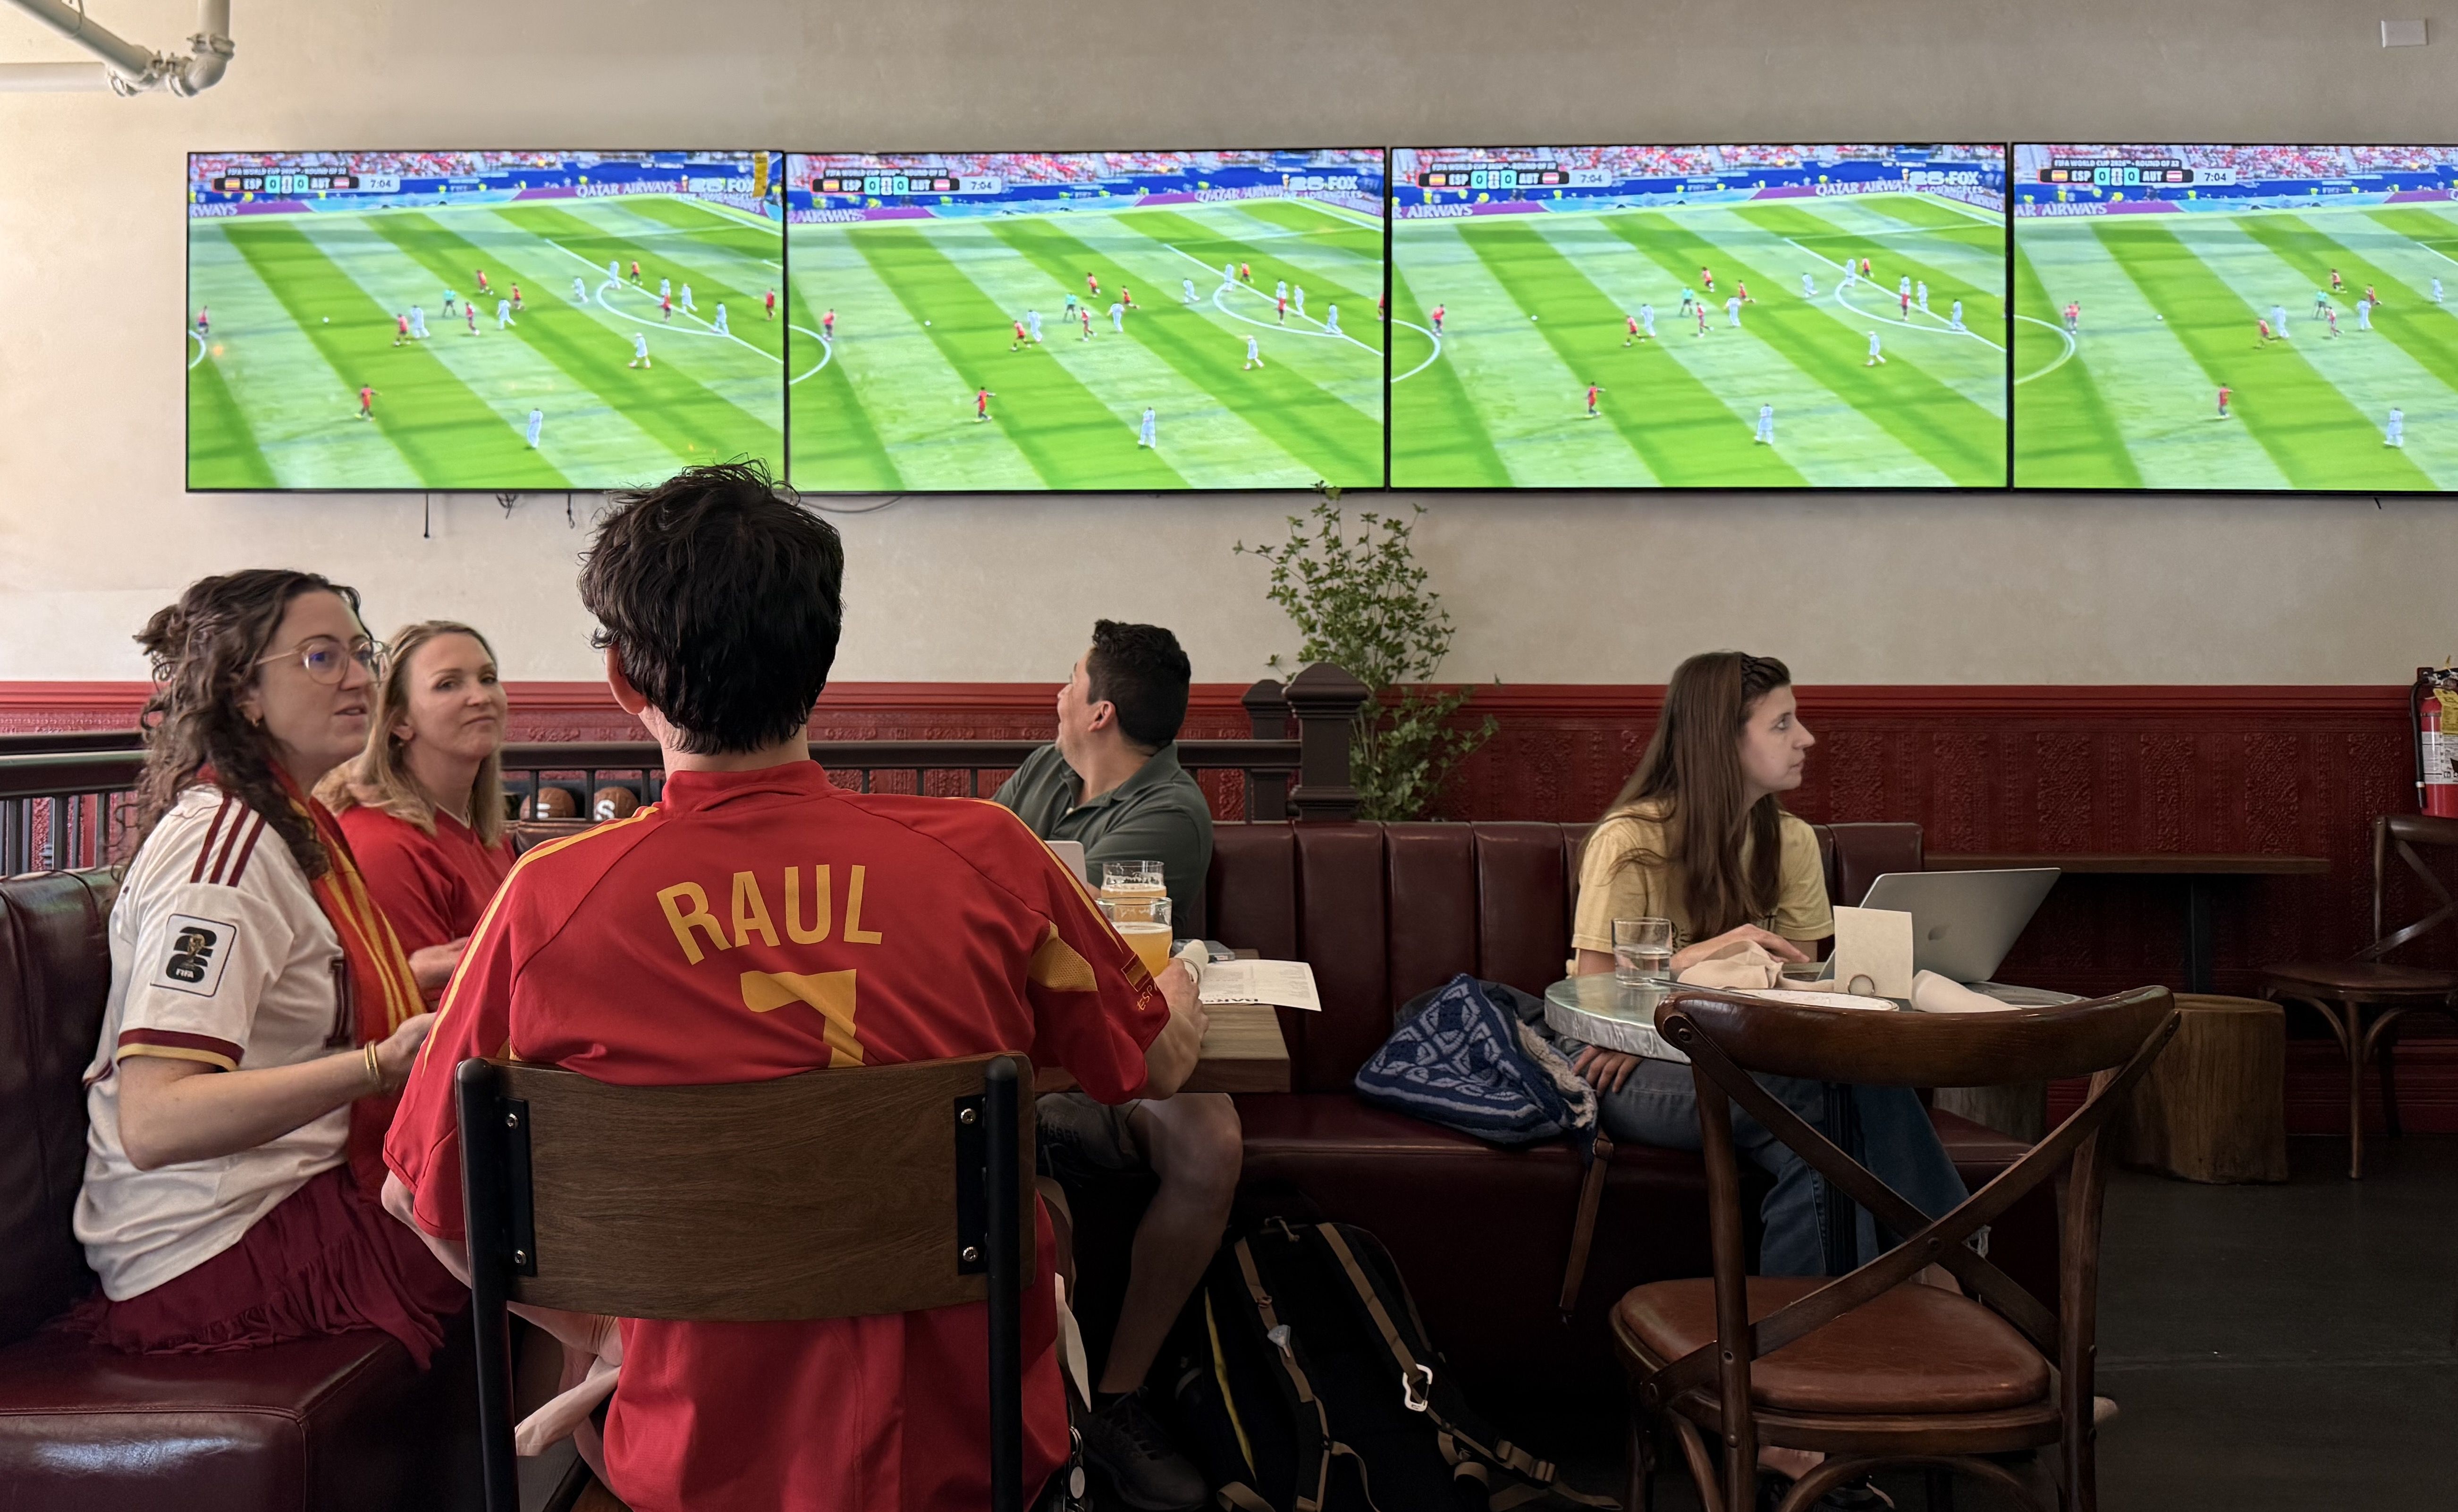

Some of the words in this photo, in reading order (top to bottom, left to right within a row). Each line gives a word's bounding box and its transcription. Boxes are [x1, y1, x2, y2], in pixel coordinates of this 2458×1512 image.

[243, 177, 262, 189] ESP
[270, 179, 276, 189] 0
[298, 179, 304, 188] 0
[371, 180, 391, 188] 7:04
[1328, 176, 1358, 190] FOX
[1476, 175, 1483, 184] 0
[1505, 175, 1512, 184] 0
[1580, 175, 1602, 183] 7:04
[1949, 171, 1979, 185] FOX
[2071, 170, 2091, 182] ESP
[2099, 171, 2106, 181] 0
[2128, 172, 2135, 181] 0
[2142, 170, 2162, 182] AUT
[2205, 173, 2226, 181] 7:04
[575, 183, 619, 197] QATAR
[623, 181, 677, 194] AIRWAYS
[870, 181, 876, 190] 0
[897, 181, 904, 190] 0
[971, 181, 991, 189] 7:04
[1816, 182, 1859, 196] QATAR
[1406, 203, 1473, 218] AIRWAYS
[2042, 202, 2107, 216] AIRWAYS
[657, 864, 882, 965] RAUL
[175, 968, 194, 979] FIFA
[1137, 982, 1157, 1011] ESP
[740, 969, 866, 1068] 7
